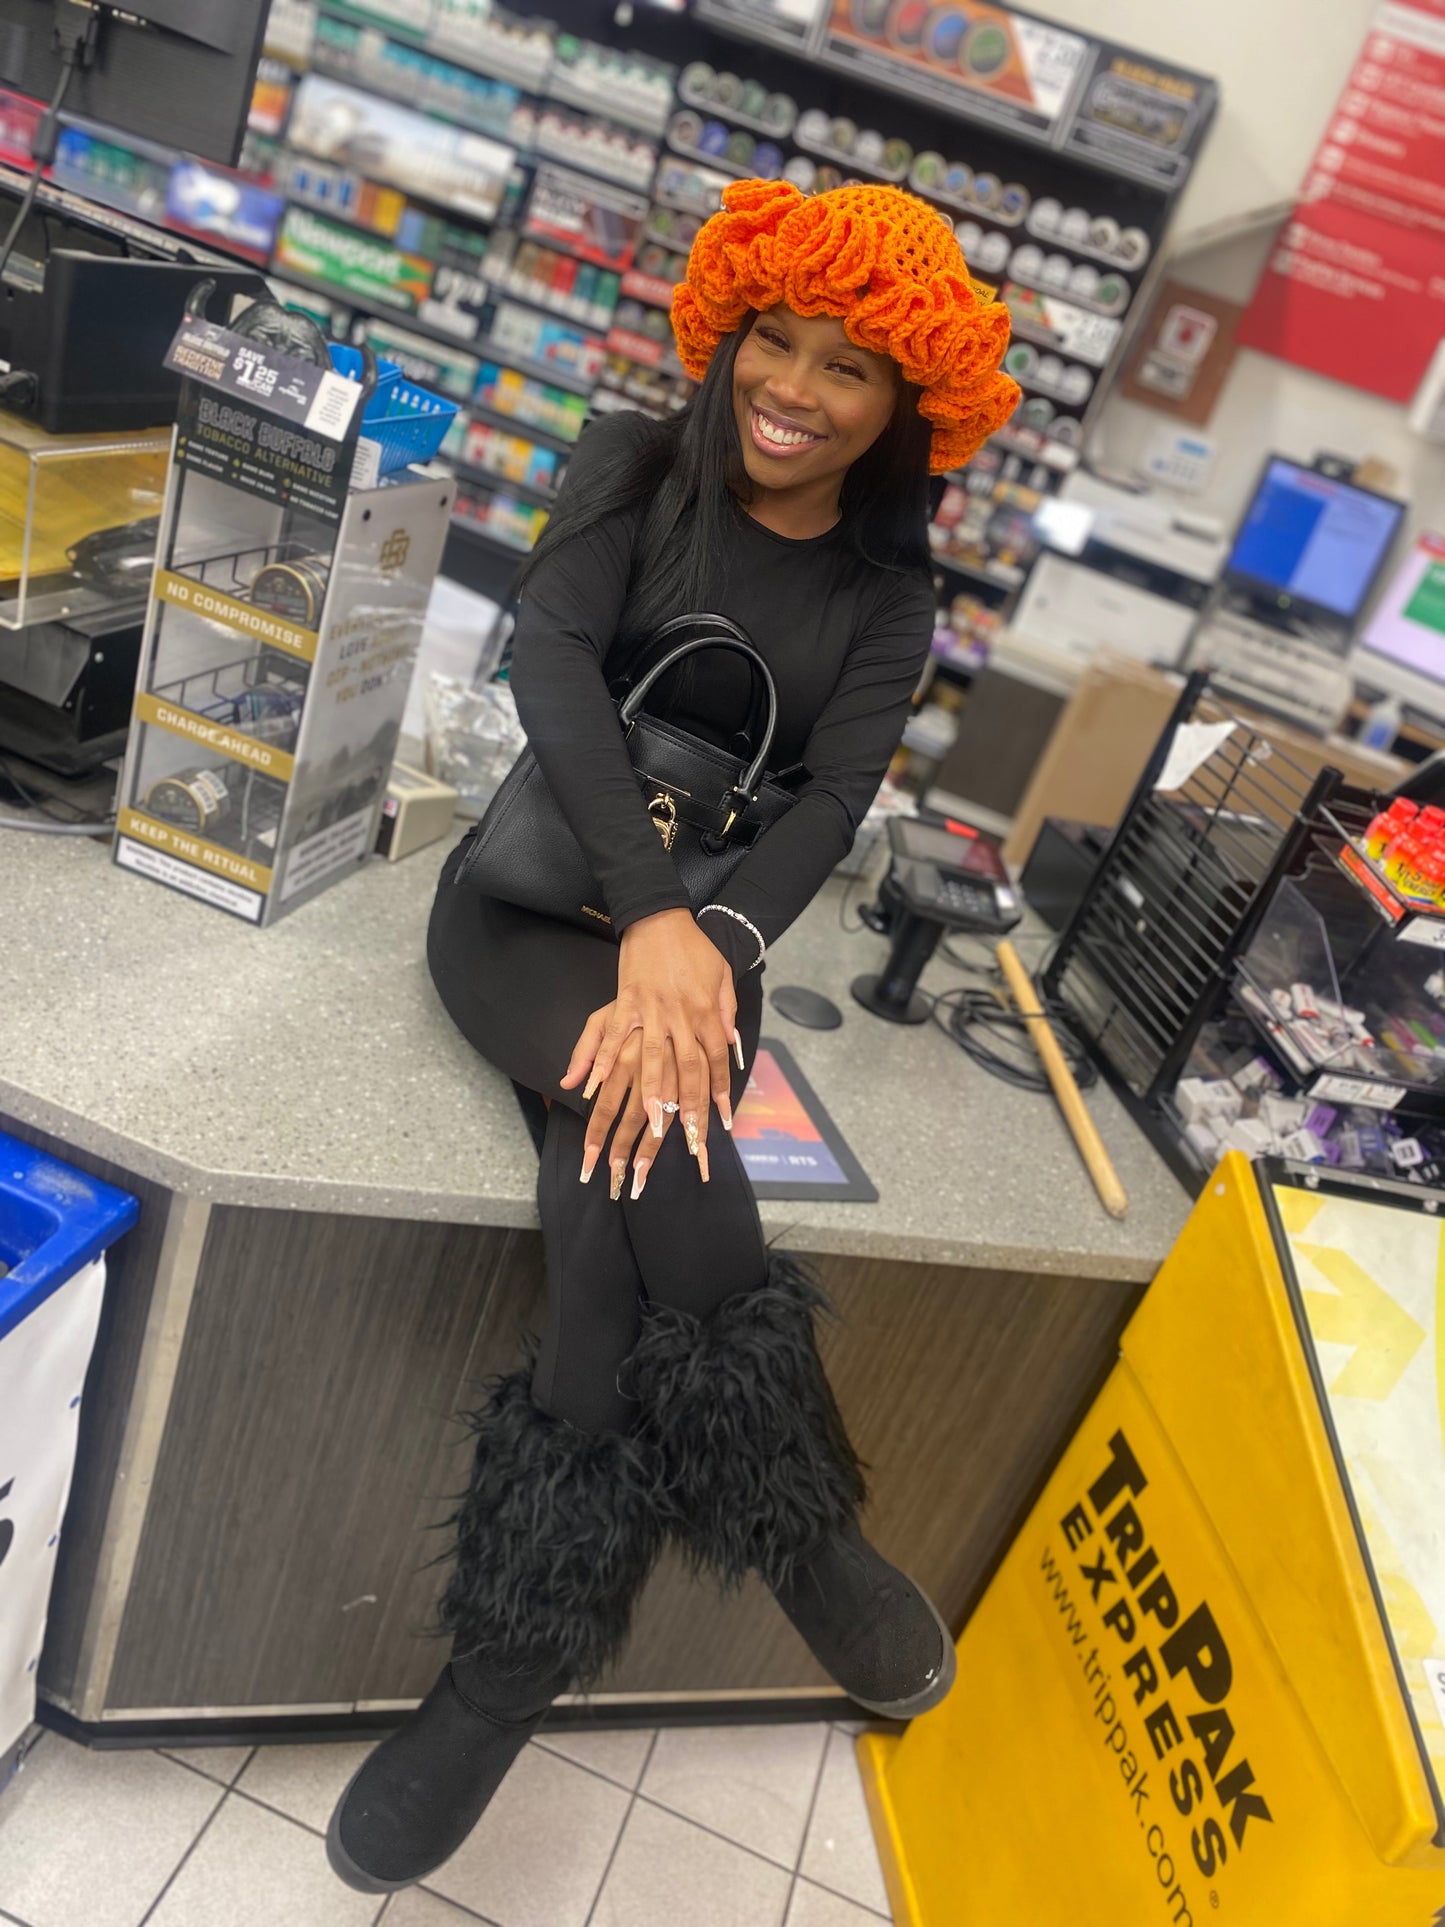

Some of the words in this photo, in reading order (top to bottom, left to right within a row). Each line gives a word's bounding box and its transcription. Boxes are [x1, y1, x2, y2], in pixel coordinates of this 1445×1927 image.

[237, 347, 266, 365] SAVE
[197, 424, 250, 454] TOBACCO
[254, 447, 333, 488] ALTERNATIVE
[199, 398, 257, 441] BLACK
[258, 422, 336, 472] BUFFALO
[167, 581, 189, 600] NO
[193, 592, 304, 649] COMPROMISE
[157, 708, 219, 743] CHARGE
[219, 731, 272, 767] AHEAD
[130, 818, 168, 842] KEEP
[172, 835, 200, 858] THE
[203, 850, 257, 882] RITUAL
[580, 905, 611, 924] MICHAEL
[1041, 1546, 1193, 1927] www.trippak.com
